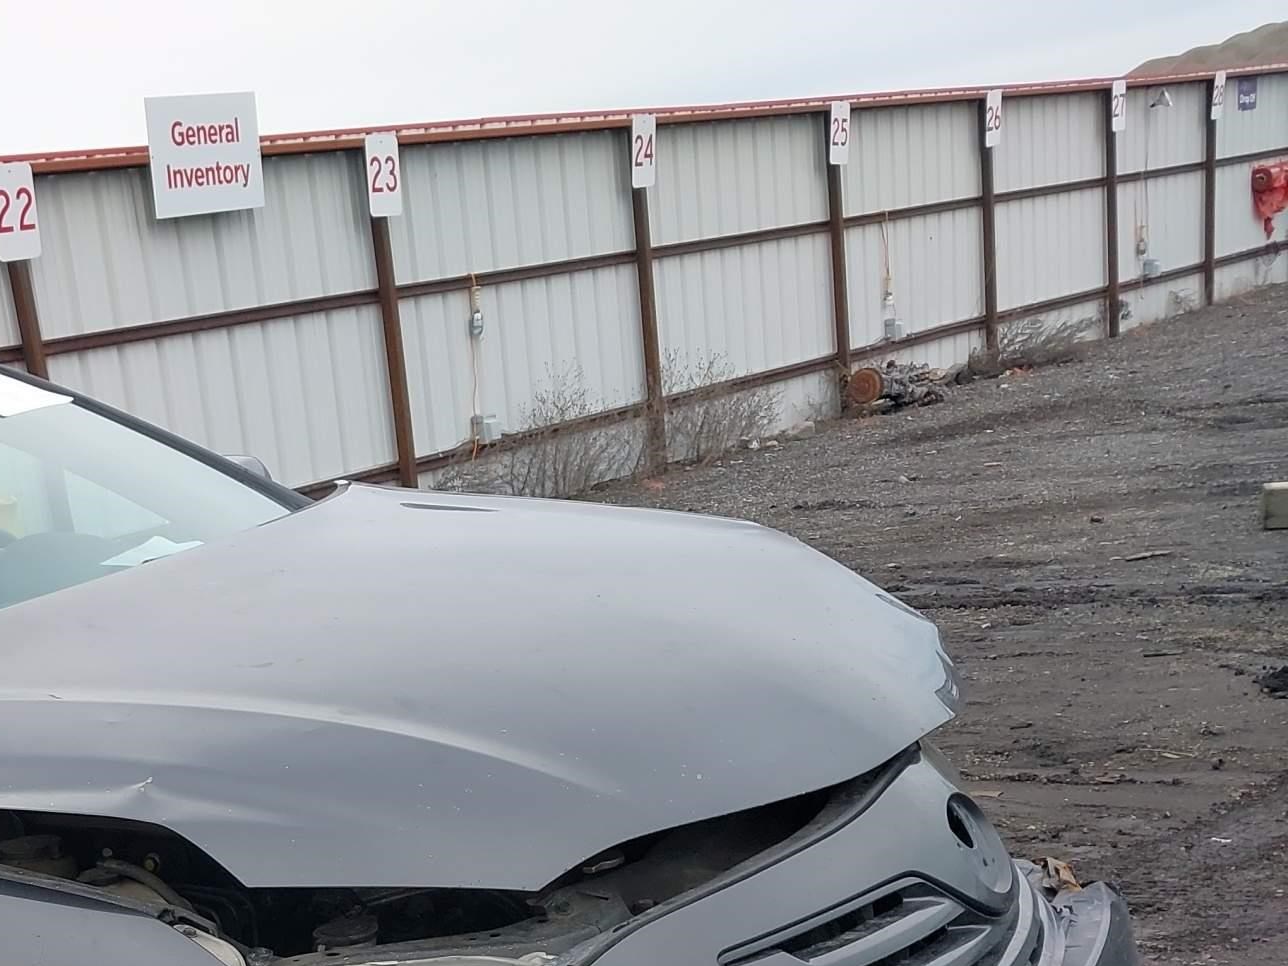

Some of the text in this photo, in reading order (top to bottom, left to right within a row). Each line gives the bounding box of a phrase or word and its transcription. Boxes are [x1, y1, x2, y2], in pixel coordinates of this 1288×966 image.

[986, 106, 1001, 132] 26
[1113, 93, 1127, 118] 27
[171, 117, 240, 147] General
[832, 118, 848, 146] 25
[634, 134, 654, 167] 24
[167, 161, 251, 190] Inventory
[370, 156, 398, 193] 23
